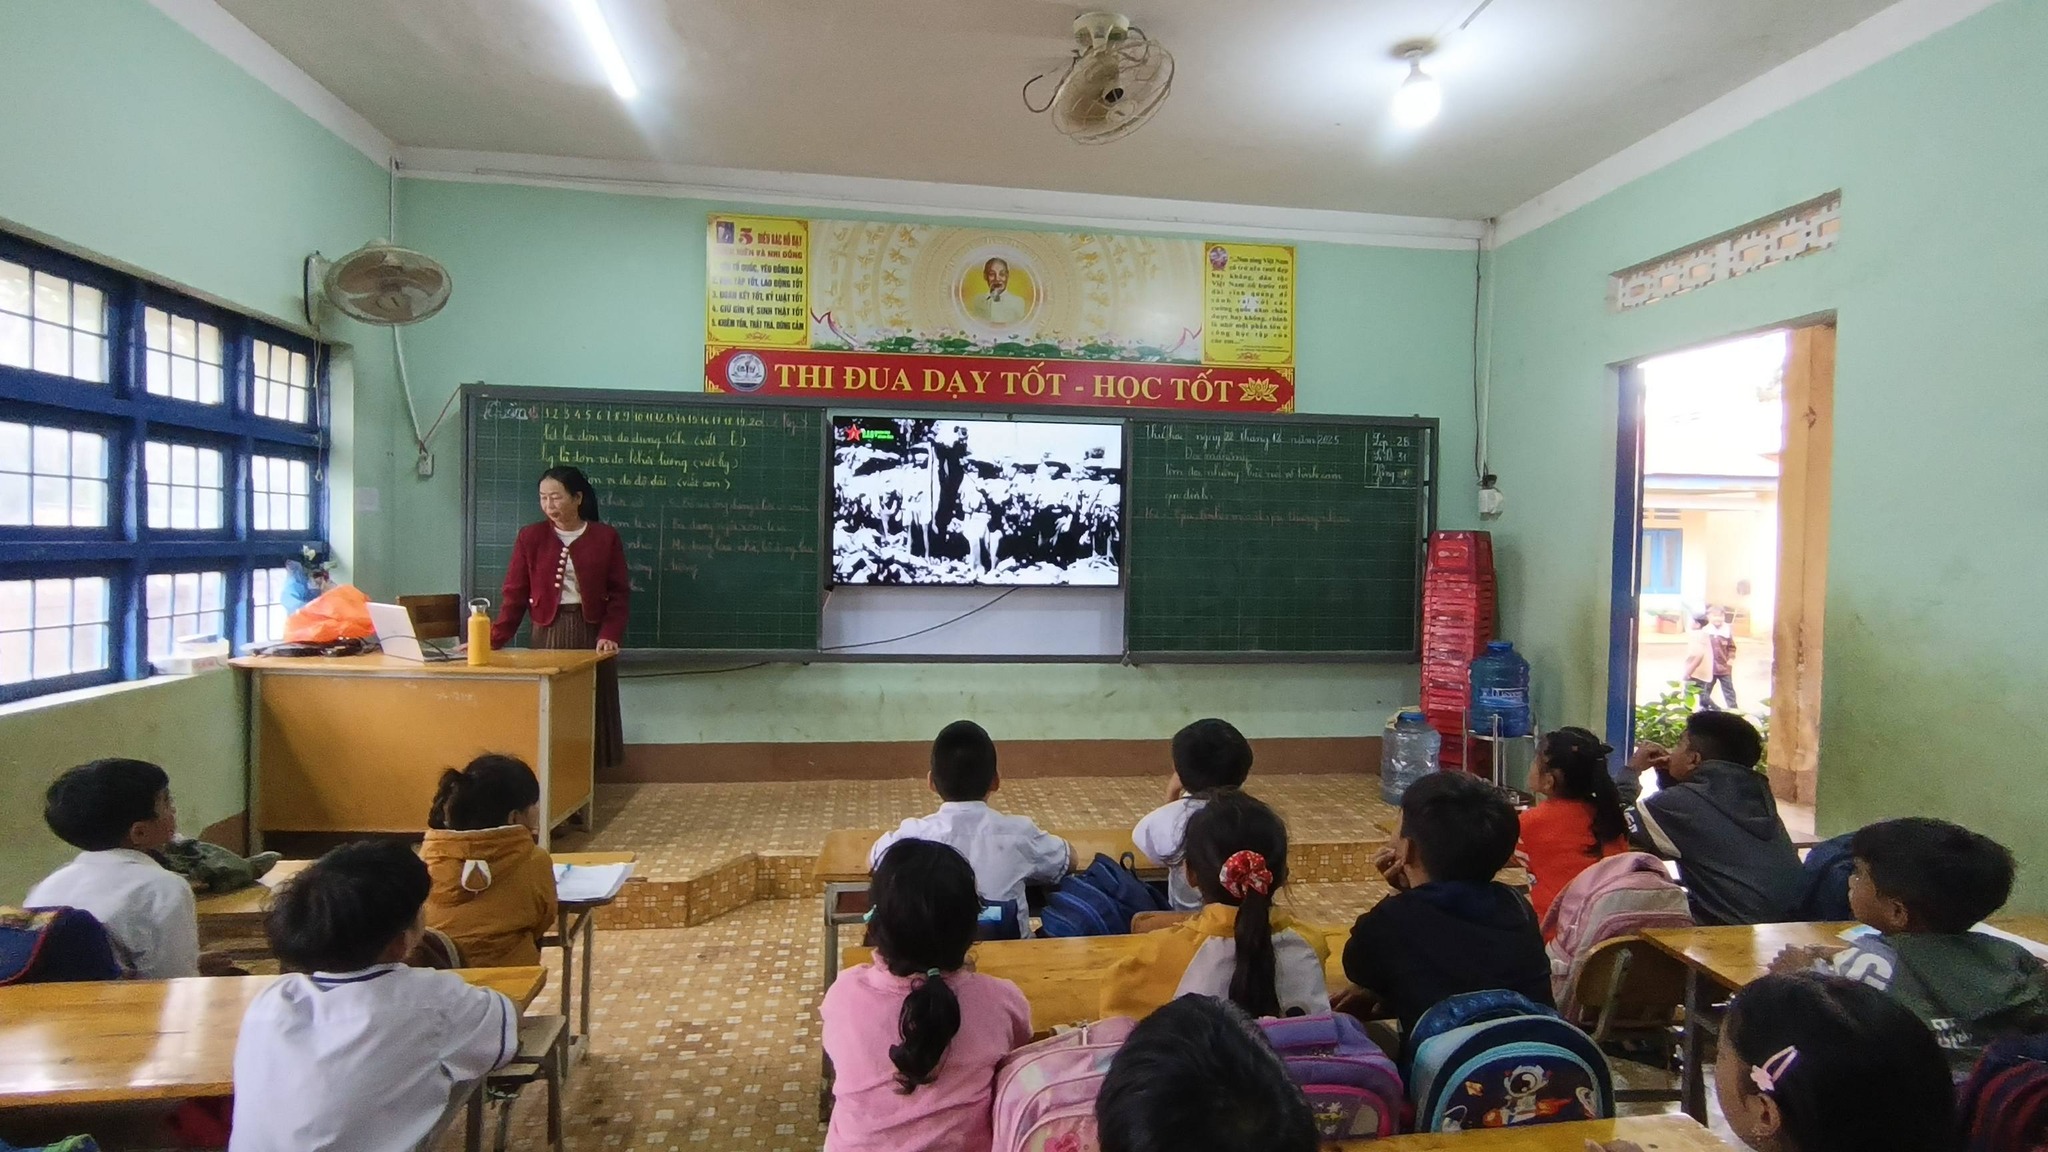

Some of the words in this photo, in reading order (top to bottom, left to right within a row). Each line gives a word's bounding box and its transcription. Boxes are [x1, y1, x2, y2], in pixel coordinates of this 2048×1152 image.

[738, 227, 753, 245] 5
[774, 364, 835, 390] THI
[843, 367, 913, 392] ĐUA
[922, 368, 992, 399] DẠY
[1000, 362, 1067, 397] TỐT
[1092, 375, 1163, 405] HỌC
[1170, 369, 1234, 403] TỐT
[552, 408, 559, 420] 2
[564, 408, 570, 419] 3
[574, 409, 581, 420] 4
[585, 409, 592, 420] 5
[596, 409, 602, 421] 6
[614, 411, 620, 421] 8
[623, 411, 631, 422] 9
[634, 412, 644, 422] 10
[748, 417, 765, 426] 20
[1223, 431, 1234, 442] 22
[1317, 434, 1340, 445] 2025
